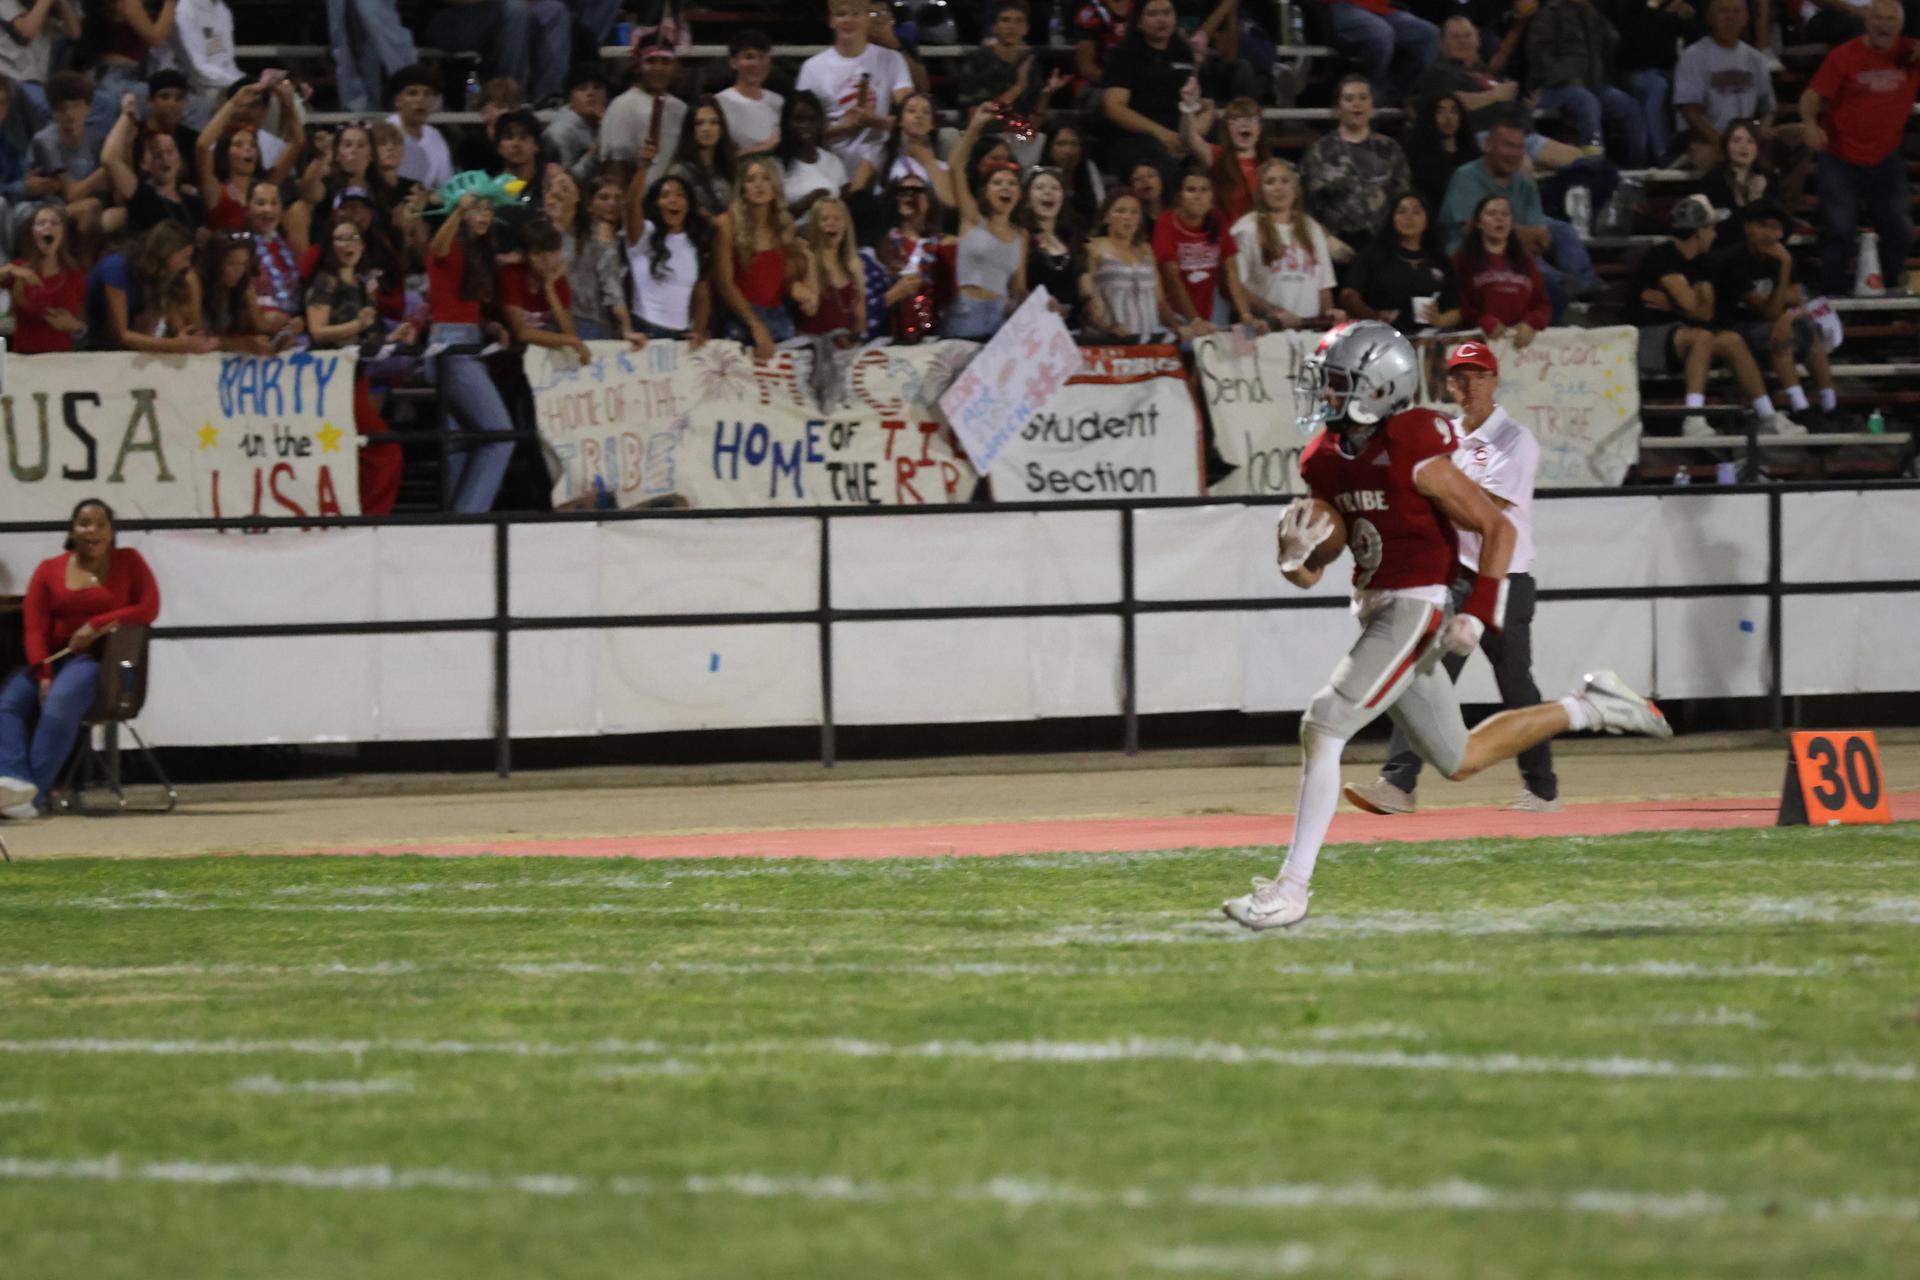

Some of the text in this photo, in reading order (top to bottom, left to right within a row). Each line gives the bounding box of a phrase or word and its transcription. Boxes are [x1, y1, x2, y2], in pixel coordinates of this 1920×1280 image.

[1456, 343, 1480, 357] C
[218, 352, 339, 418] PARTY
[1201, 339, 1274, 405] Send
[2, 388, 177, 482] USA
[239, 423, 313, 457] in the
[1021, 403, 1160, 443] Student
[712, 420, 860, 498] HOME OF
[1025, 461, 1157, 493] Section
[826, 461, 882, 503] THE
[1334, 490, 1390, 513] TRIBE
[1808, 736, 1880, 811] 30
